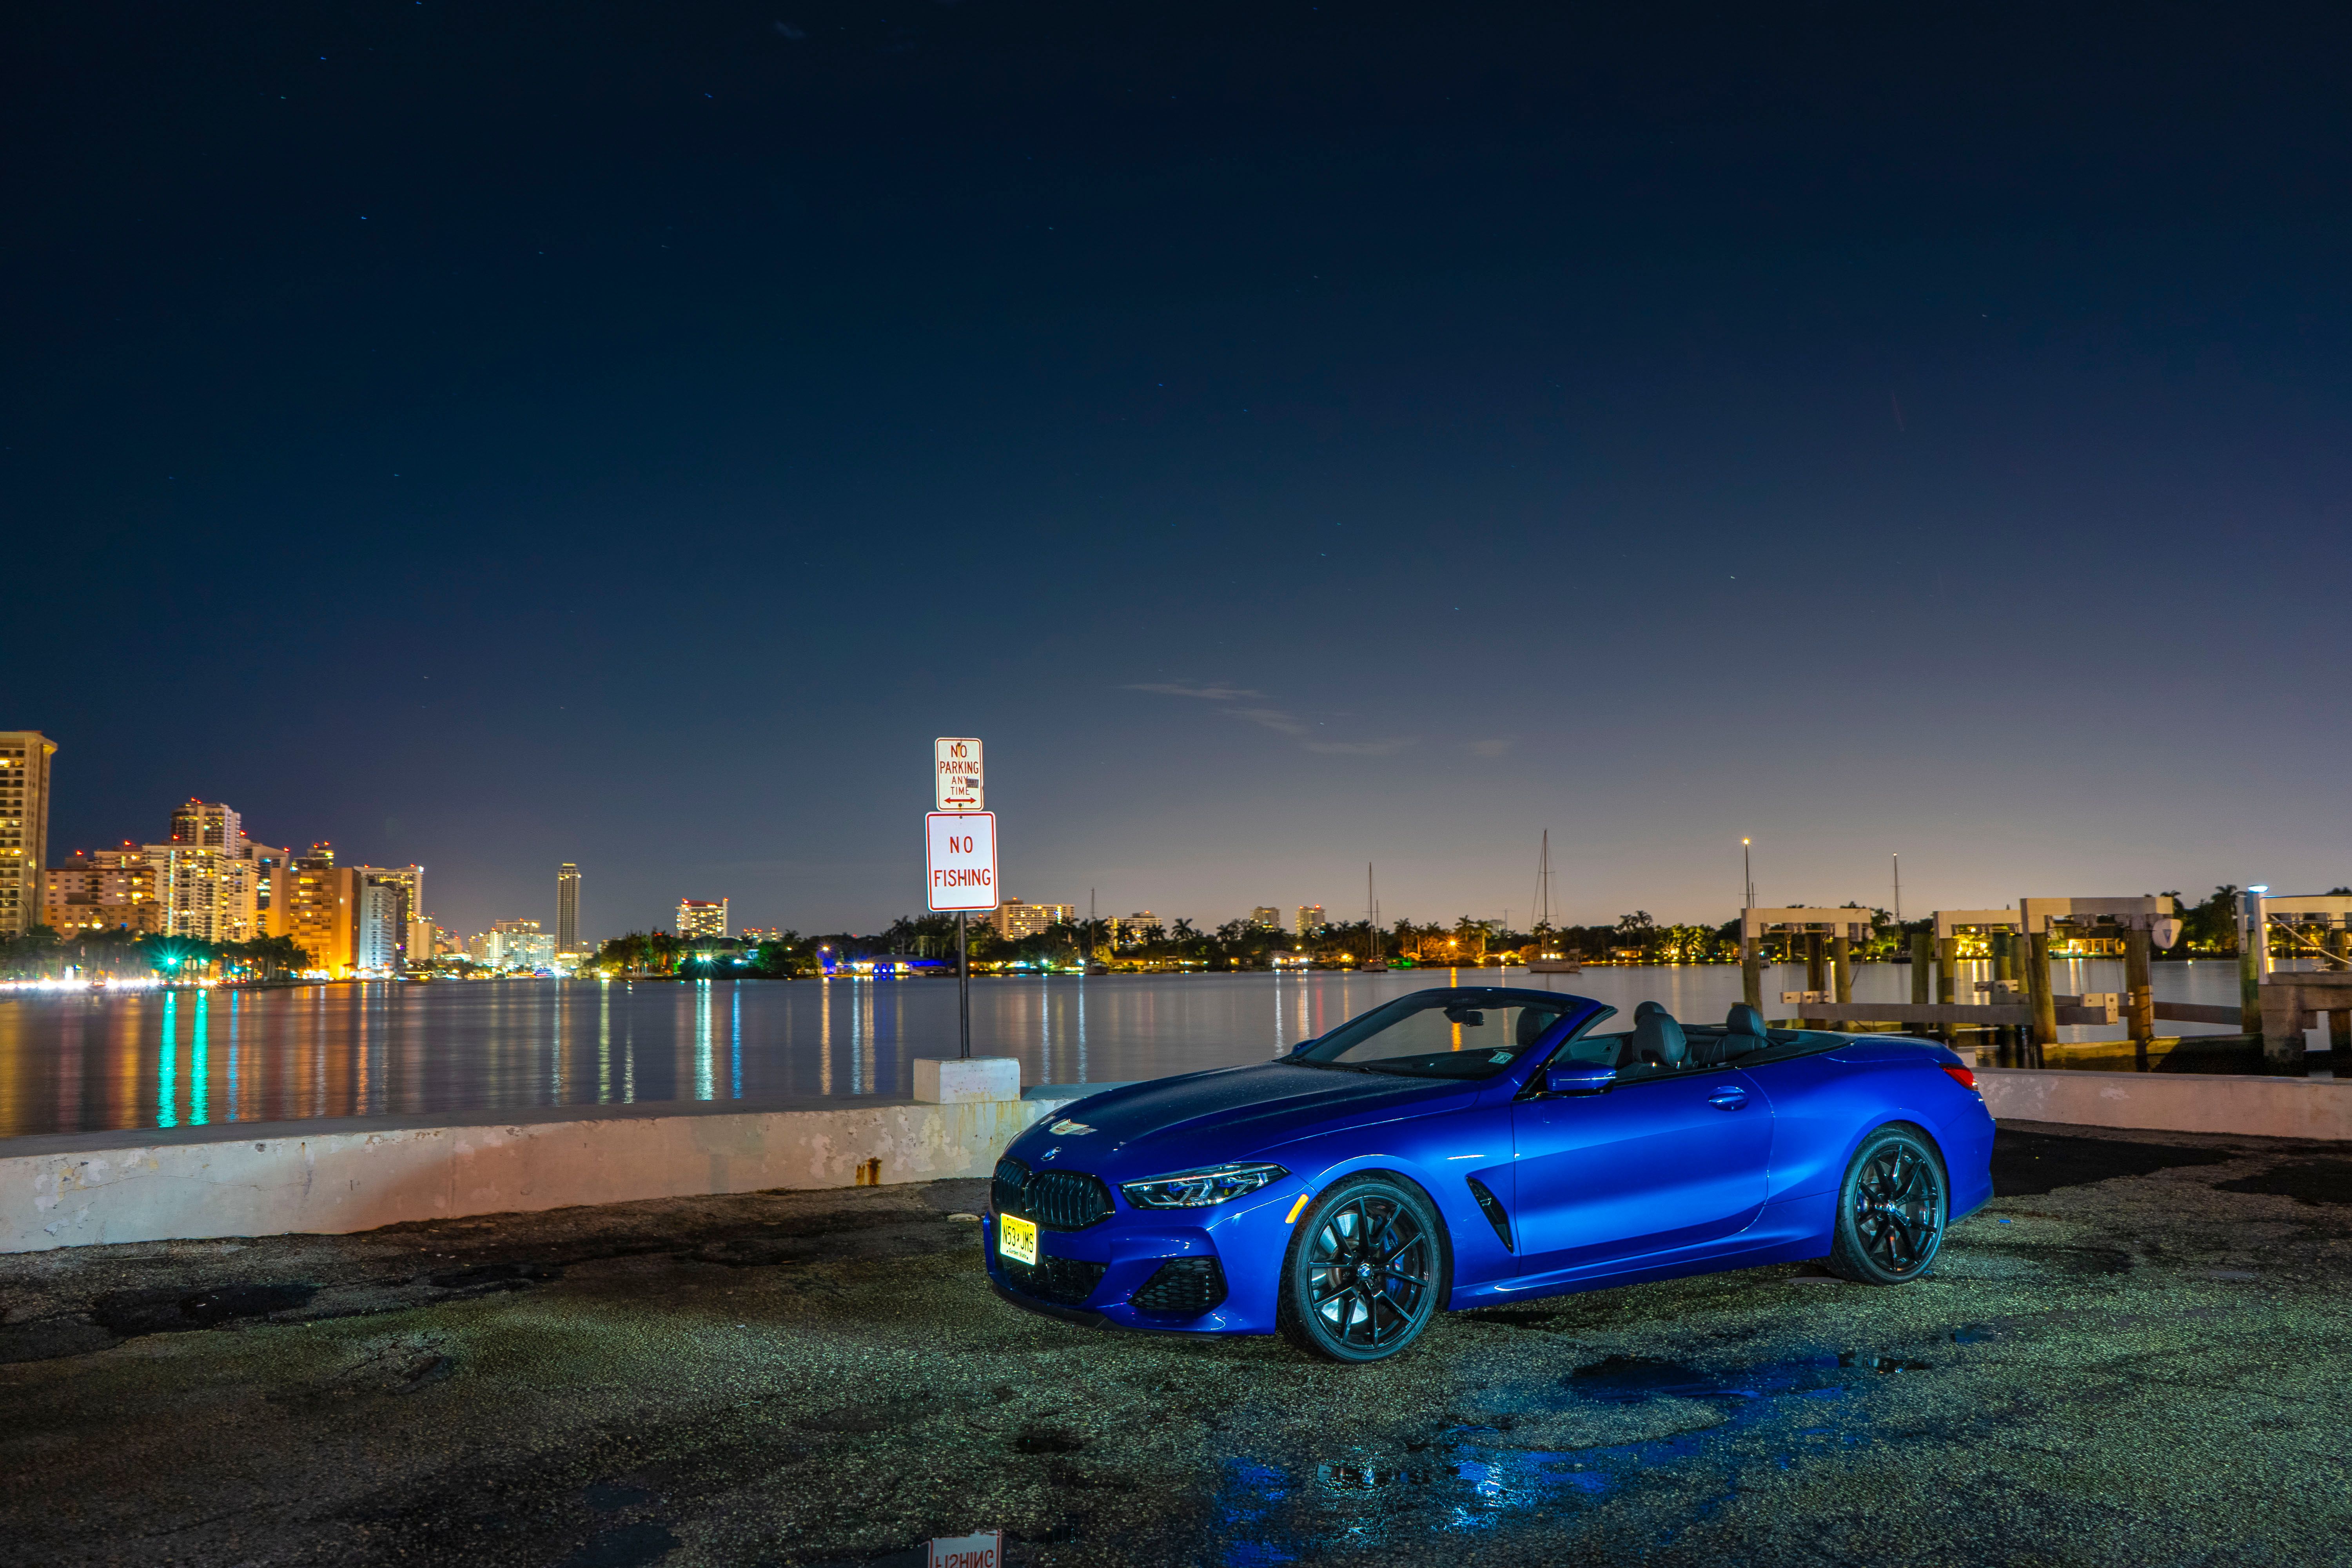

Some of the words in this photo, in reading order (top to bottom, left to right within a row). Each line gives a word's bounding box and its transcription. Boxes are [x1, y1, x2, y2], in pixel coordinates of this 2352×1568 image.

[951, 745, 967, 758] NO
[940, 761, 979, 774] PARKING
[951, 776, 968, 784] ANY
[950, 786, 970, 795] TIME
[950, 836, 973, 853] NO
[934, 868, 991, 887] FISHING
[1003, 1224, 1016, 1247] N53
[1020, 1230, 1033, 1253] JMS
[1009, 1248, 1018, 1256] Garden
